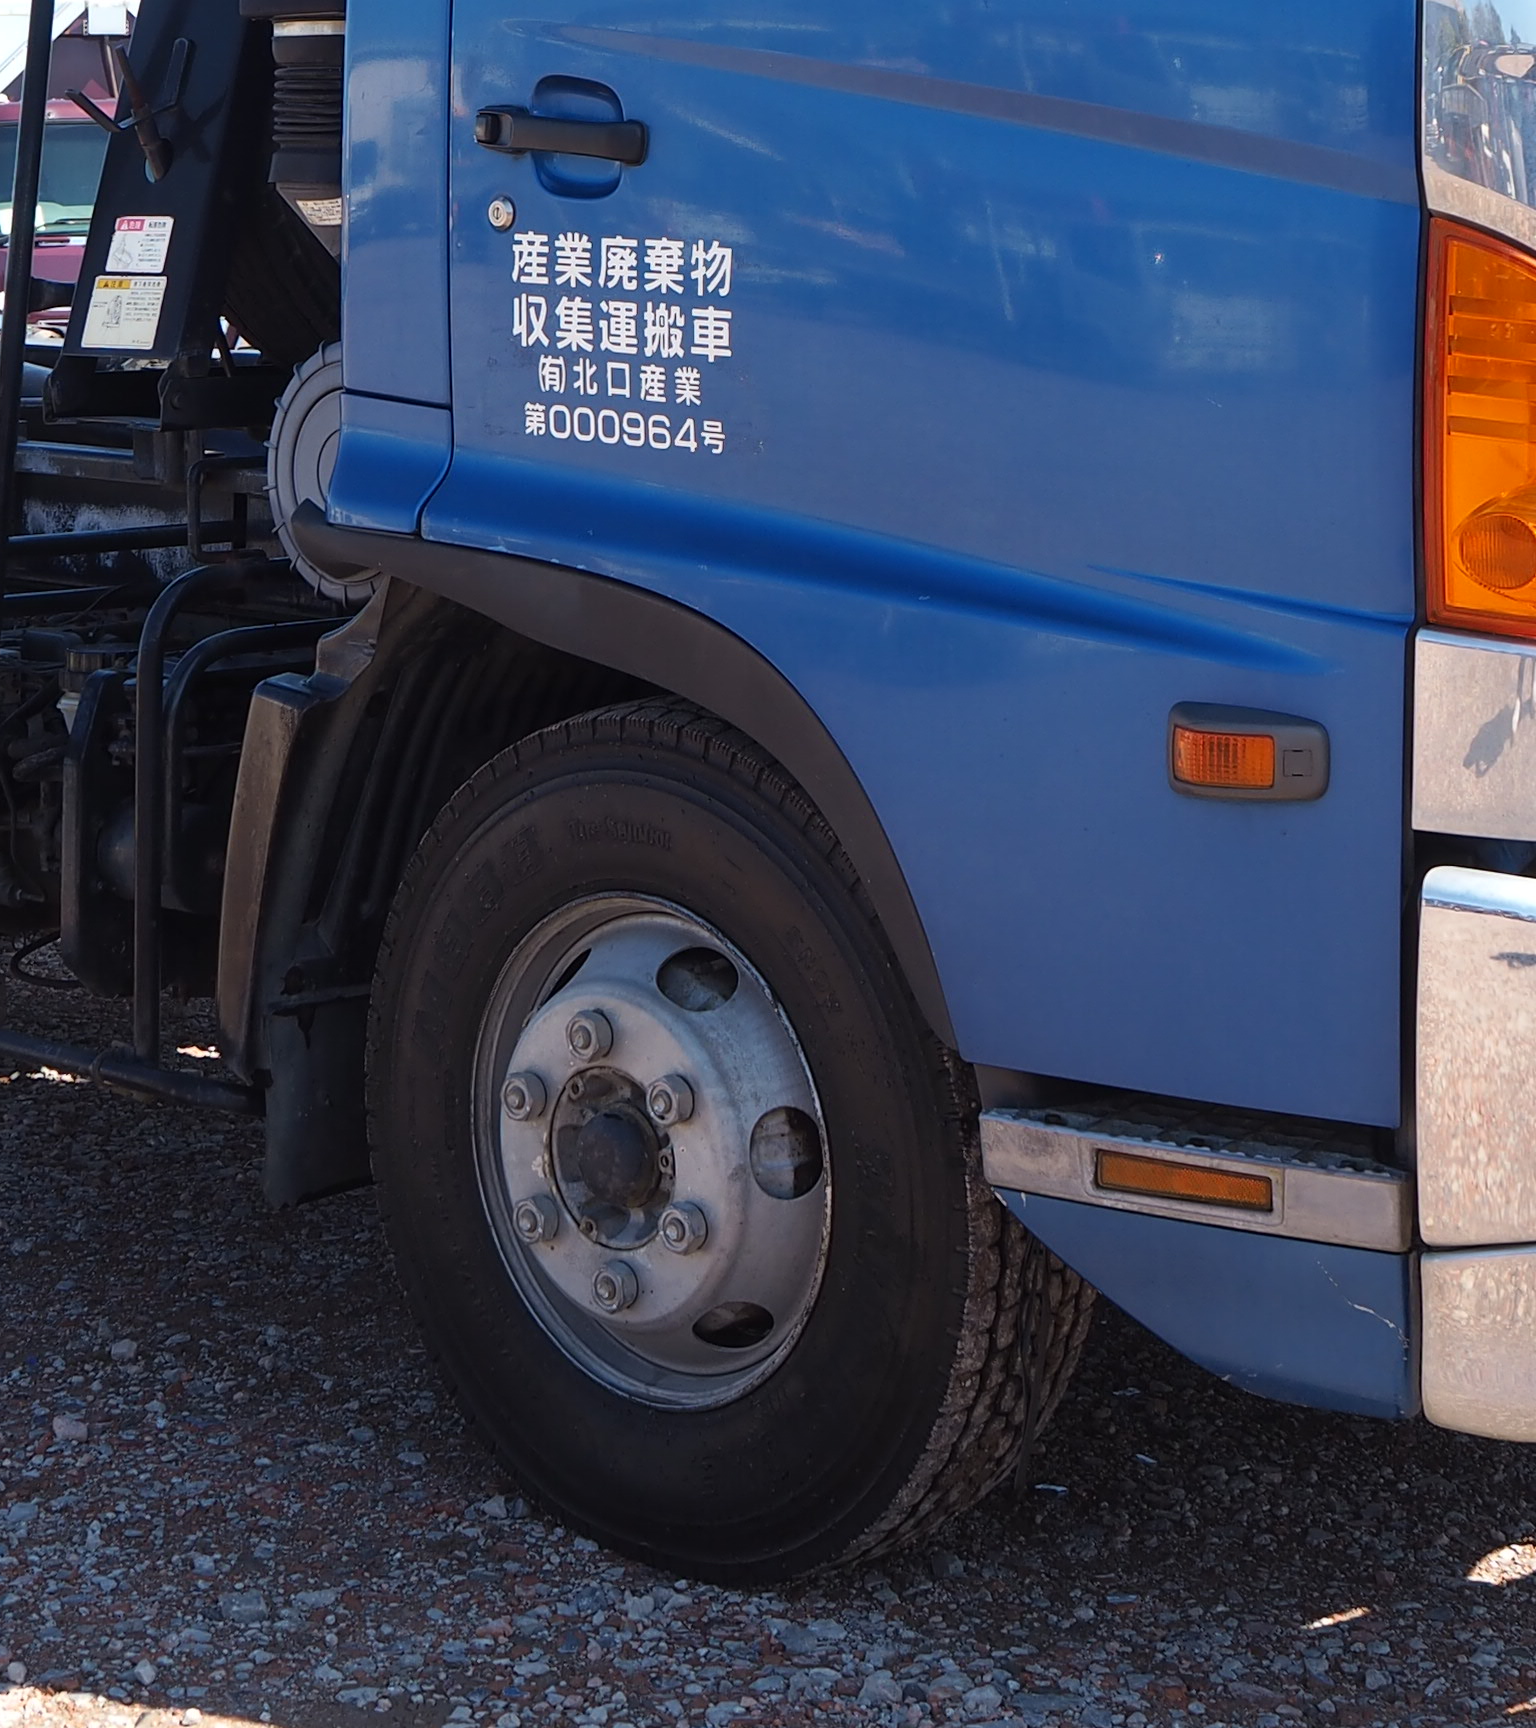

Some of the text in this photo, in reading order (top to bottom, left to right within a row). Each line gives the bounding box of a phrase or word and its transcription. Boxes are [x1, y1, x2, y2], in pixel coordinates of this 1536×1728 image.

[511, 230, 733, 297] 産業廃棄物
[512, 293, 733, 363] 収集運搬車
[523, 401, 726, 455] 第000964号
